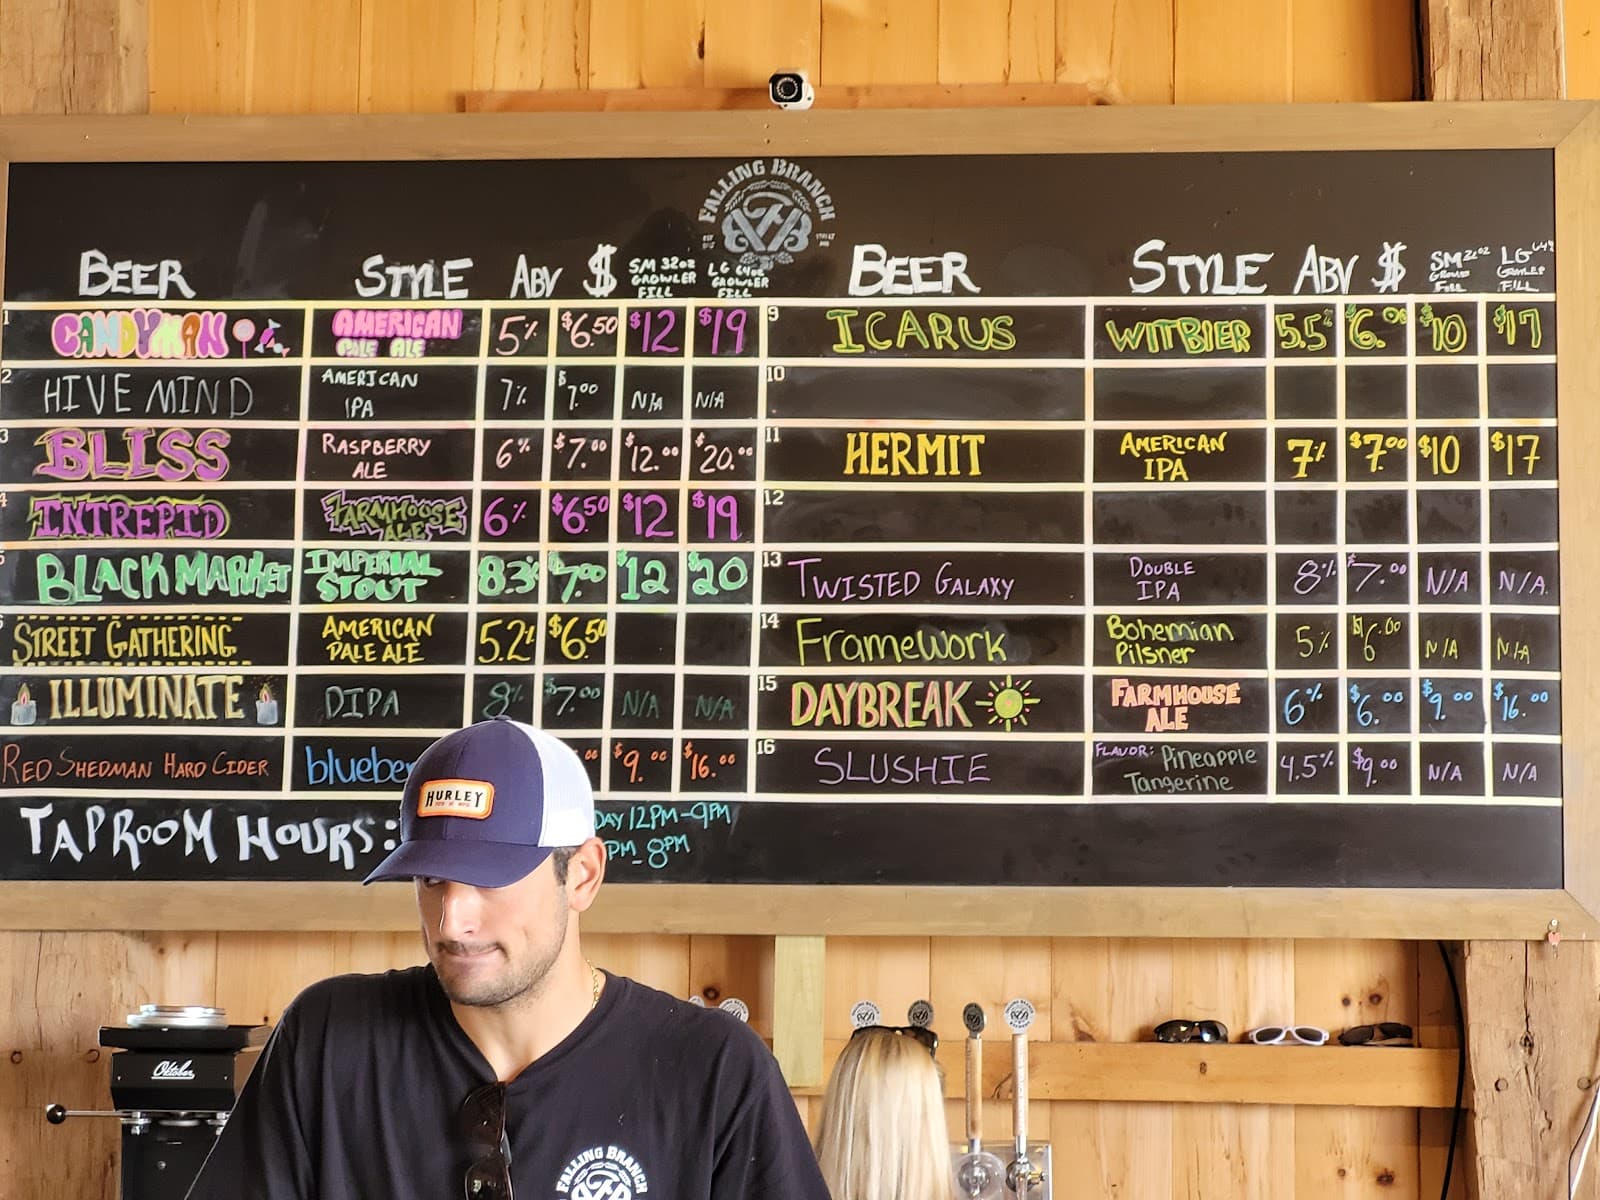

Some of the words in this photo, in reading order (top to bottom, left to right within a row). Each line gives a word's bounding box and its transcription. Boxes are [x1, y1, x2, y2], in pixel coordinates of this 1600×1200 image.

[698, 159, 766, 223] FALLING
[771, 158, 836, 221] BRANCH
[79, 249, 196, 299] BEER
[582, 244, 618, 298] $
[629, 258, 657, 273] SM
[708, 262, 730, 276] LG
[848, 244, 981, 296] BEER
[1129, 239, 1274, 295] STYLE
[1372, 242, 1406, 292] $
[1429, 250, 1463, 272] SM
[1501, 246, 1533, 266] LG
[355, 254, 473, 299] STYLE
[631, 270, 697, 285] GROWLER
[638, 286, 673, 298] FILL
[711, 277, 770, 288] GROWLER
[717, 288, 753, 298] FILL
[3, 310, 10, 325] 1
[333, 308, 463, 340] AMERICAN
[560, 312, 618, 348] $6.50
[630, 310, 678, 353] $12
[699, 307, 746, 354] $19
[768, 307, 779, 322] 9
[826, 309, 1016, 354] ICARUS
[1420, 303, 1467, 353] $10
[1493, 305, 1541, 349] $17
[51, 309, 229, 358] CANDYMAN
[336, 338, 378, 357] PALE
[390, 338, 426, 358] ALE
[496, 315, 538, 356] 5%
[1105, 317, 1252, 354] WITBIER
[1, 369, 12, 384] 2
[322, 369, 418, 388] AMERICAN
[558, 370, 598, 410] $7.00
[766, 366, 785, 382] 10
[44, 373, 131, 415] HIVE
[145, 375, 253, 418] MIND
[345, 397, 374, 418] IPA
[501, 379, 528, 410] 7%
[632, 391, 663, 411] N/A
[695, 391, 725, 409] N/A
[0, 429, 8, 444] 3
[322, 433, 431, 457] RASPBERRY
[554, 432, 607, 470] $7.00
[765, 426, 780, 442] 11
[1120, 432, 1226, 457] AMERICAN
[33, 428, 231, 481] BLISS
[352, 462, 388, 479] ALE
[496, 438, 530, 468] 6%
[625, 432, 679, 473] $12.00
[695, 432, 753, 473] $20.00
[843, 432, 985, 476] HERMIT
[1144, 458, 1189, 481] IPA
[1287, 439, 1326, 478] 7%
[1349, 432, 1407, 473] $7.00
[1418, 435, 1460, 474] $10
[1491, 431, 1540, 475] $17
[325, 491, 464, 532] FARMHOUSE
[552, 494, 609, 534] $6.50
[624, 493, 674, 537] $12
[764, 489, 784, 505] 12
[27, 493, 231, 540] INTREPID
[484, 497, 526, 536] 6%
[692, 491, 743, 540] $19
[304, 550, 443, 576] IMPERIAL
[617, 550, 668, 599] $12
[687, 551, 748, 596] $20
[762, 552, 782, 567] 13
[1130, 557, 1195, 578] DOUBLE
[1294, 559, 1337, 594] 8%
[36, 552, 170, 606] BLACK
[175, 551, 292, 598] MARKET
[317, 574, 427, 603] STOUT
[787, 557, 921, 601] TWISTED
[935, 561, 1014, 600] GALAXY
[1137, 580, 1181, 601] IPA
[1427, 567, 1468, 595] N/A
[322, 614, 434, 640] AMERICAN
[548, 616, 608, 660] $6.50
[761, 613, 780, 629] 14
[1107, 614, 1235, 641] Bohemian
[1353, 616, 1401, 661] $6.00
[12, 622, 96, 662] STREET
[107, 619, 237, 659] GATHERING
[327, 642, 374, 663] PALE
[382, 641, 424, 663] ALE
[478, 619, 536, 663] 5.2%
[1116, 642, 1195, 664] Pilsner
[1296, 625, 1331, 659] 5%
[1425, 637, 1458, 659] N/A
[1497, 637, 1530, 662] N/A
[49, 674, 246, 720] ILLUMINATE
[482, 682, 524, 719] 8%
[544, 678, 600, 716] $7.00
[758, 675, 777, 691] 15
[1111, 679, 1241, 707] FARMHOUSE
[1422, 681, 1473, 721] $9.00
[325, 686, 400, 719] DIPA
[622, 691, 659, 718] N/A
[695, 693, 733, 718] N/A
[791, 681, 974, 728] DAYBREAK
[1284, 682, 1323, 726] 6%
[1351, 684, 1403, 726] $6.00
[1494, 683, 1549, 720] $16.00
[1146, 708, 1189, 732] ALE
[2, 744, 52, 784] RED
[56, 747, 152, 779] SHEDMAN
[164, 752, 205, 779] HARD
[211, 751, 270, 777] CIDER
[614, 741, 667, 783] $9.00
[684, 742, 736, 779] $16.00
[756, 738, 775, 754] 16
[1095, 743, 1154, 758] FLAVOR:
[1161, 745, 1257, 769] Pineapple
[814, 747, 991, 785] SLUSHIE
[1124, 771, 1233, 795] Tangerine
[1280, 750, 1334, 783] 4.5%
[1353, 747, 1398, 787] $9.00
[1429, 763, 1462, 782] N/A
[1503, 763, 1537, 782] N/A
[425, 789, 483, 807] HURLEY
[237, 815, 398, 870] HOURS:
[555, 1147, 603, 1193] FALLING
[606, 1145, 648, 1193] BRANCH
